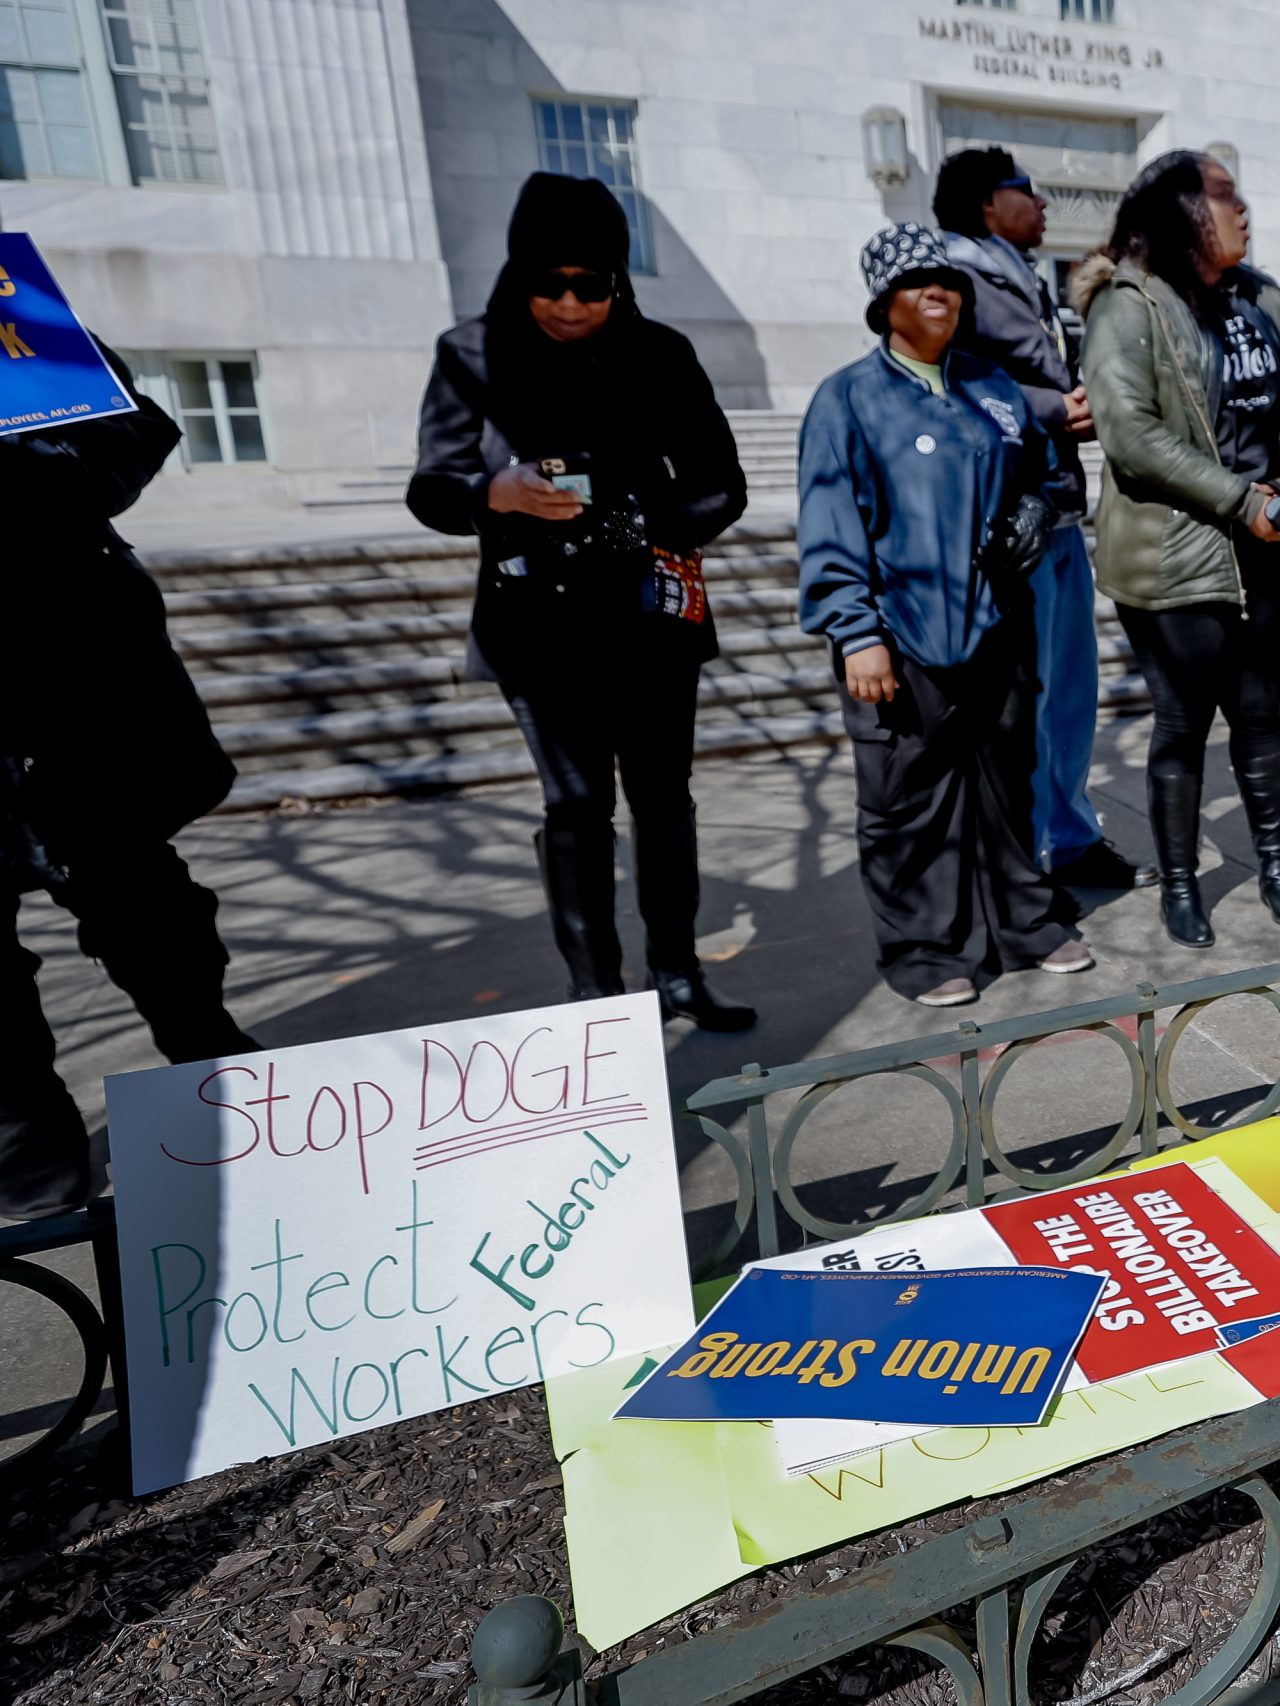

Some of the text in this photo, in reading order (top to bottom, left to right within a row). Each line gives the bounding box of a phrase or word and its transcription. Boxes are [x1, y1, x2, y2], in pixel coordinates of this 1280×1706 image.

[918, 17, 997, 47] MARTIN
[1006, 28, 1073, 60] LUTHER
[1084, 41, 1132, 67] KING
[972, 53, 1121, 91] FEDERAL BUILDING
[160, 1017, 632, 1195] Stop DOGE
[468, 1130, 632, 1312] Federal
[1032, 1213, 1095, 1263] THE
[1072, 1191, 1219, 1337] BILLIONAIRE
[1132, 1189, 1260, 1308] TAKEOVER
[150, 1179, 459, 1368] Protect
[957, 1270, 1015, 1279] FEDERATION
[1016, 1269, 1069, 1280] AMERICAN
[248, 1302, 616, 1448] Workers
[666, 1331, 1053, 1395] Union Strong
